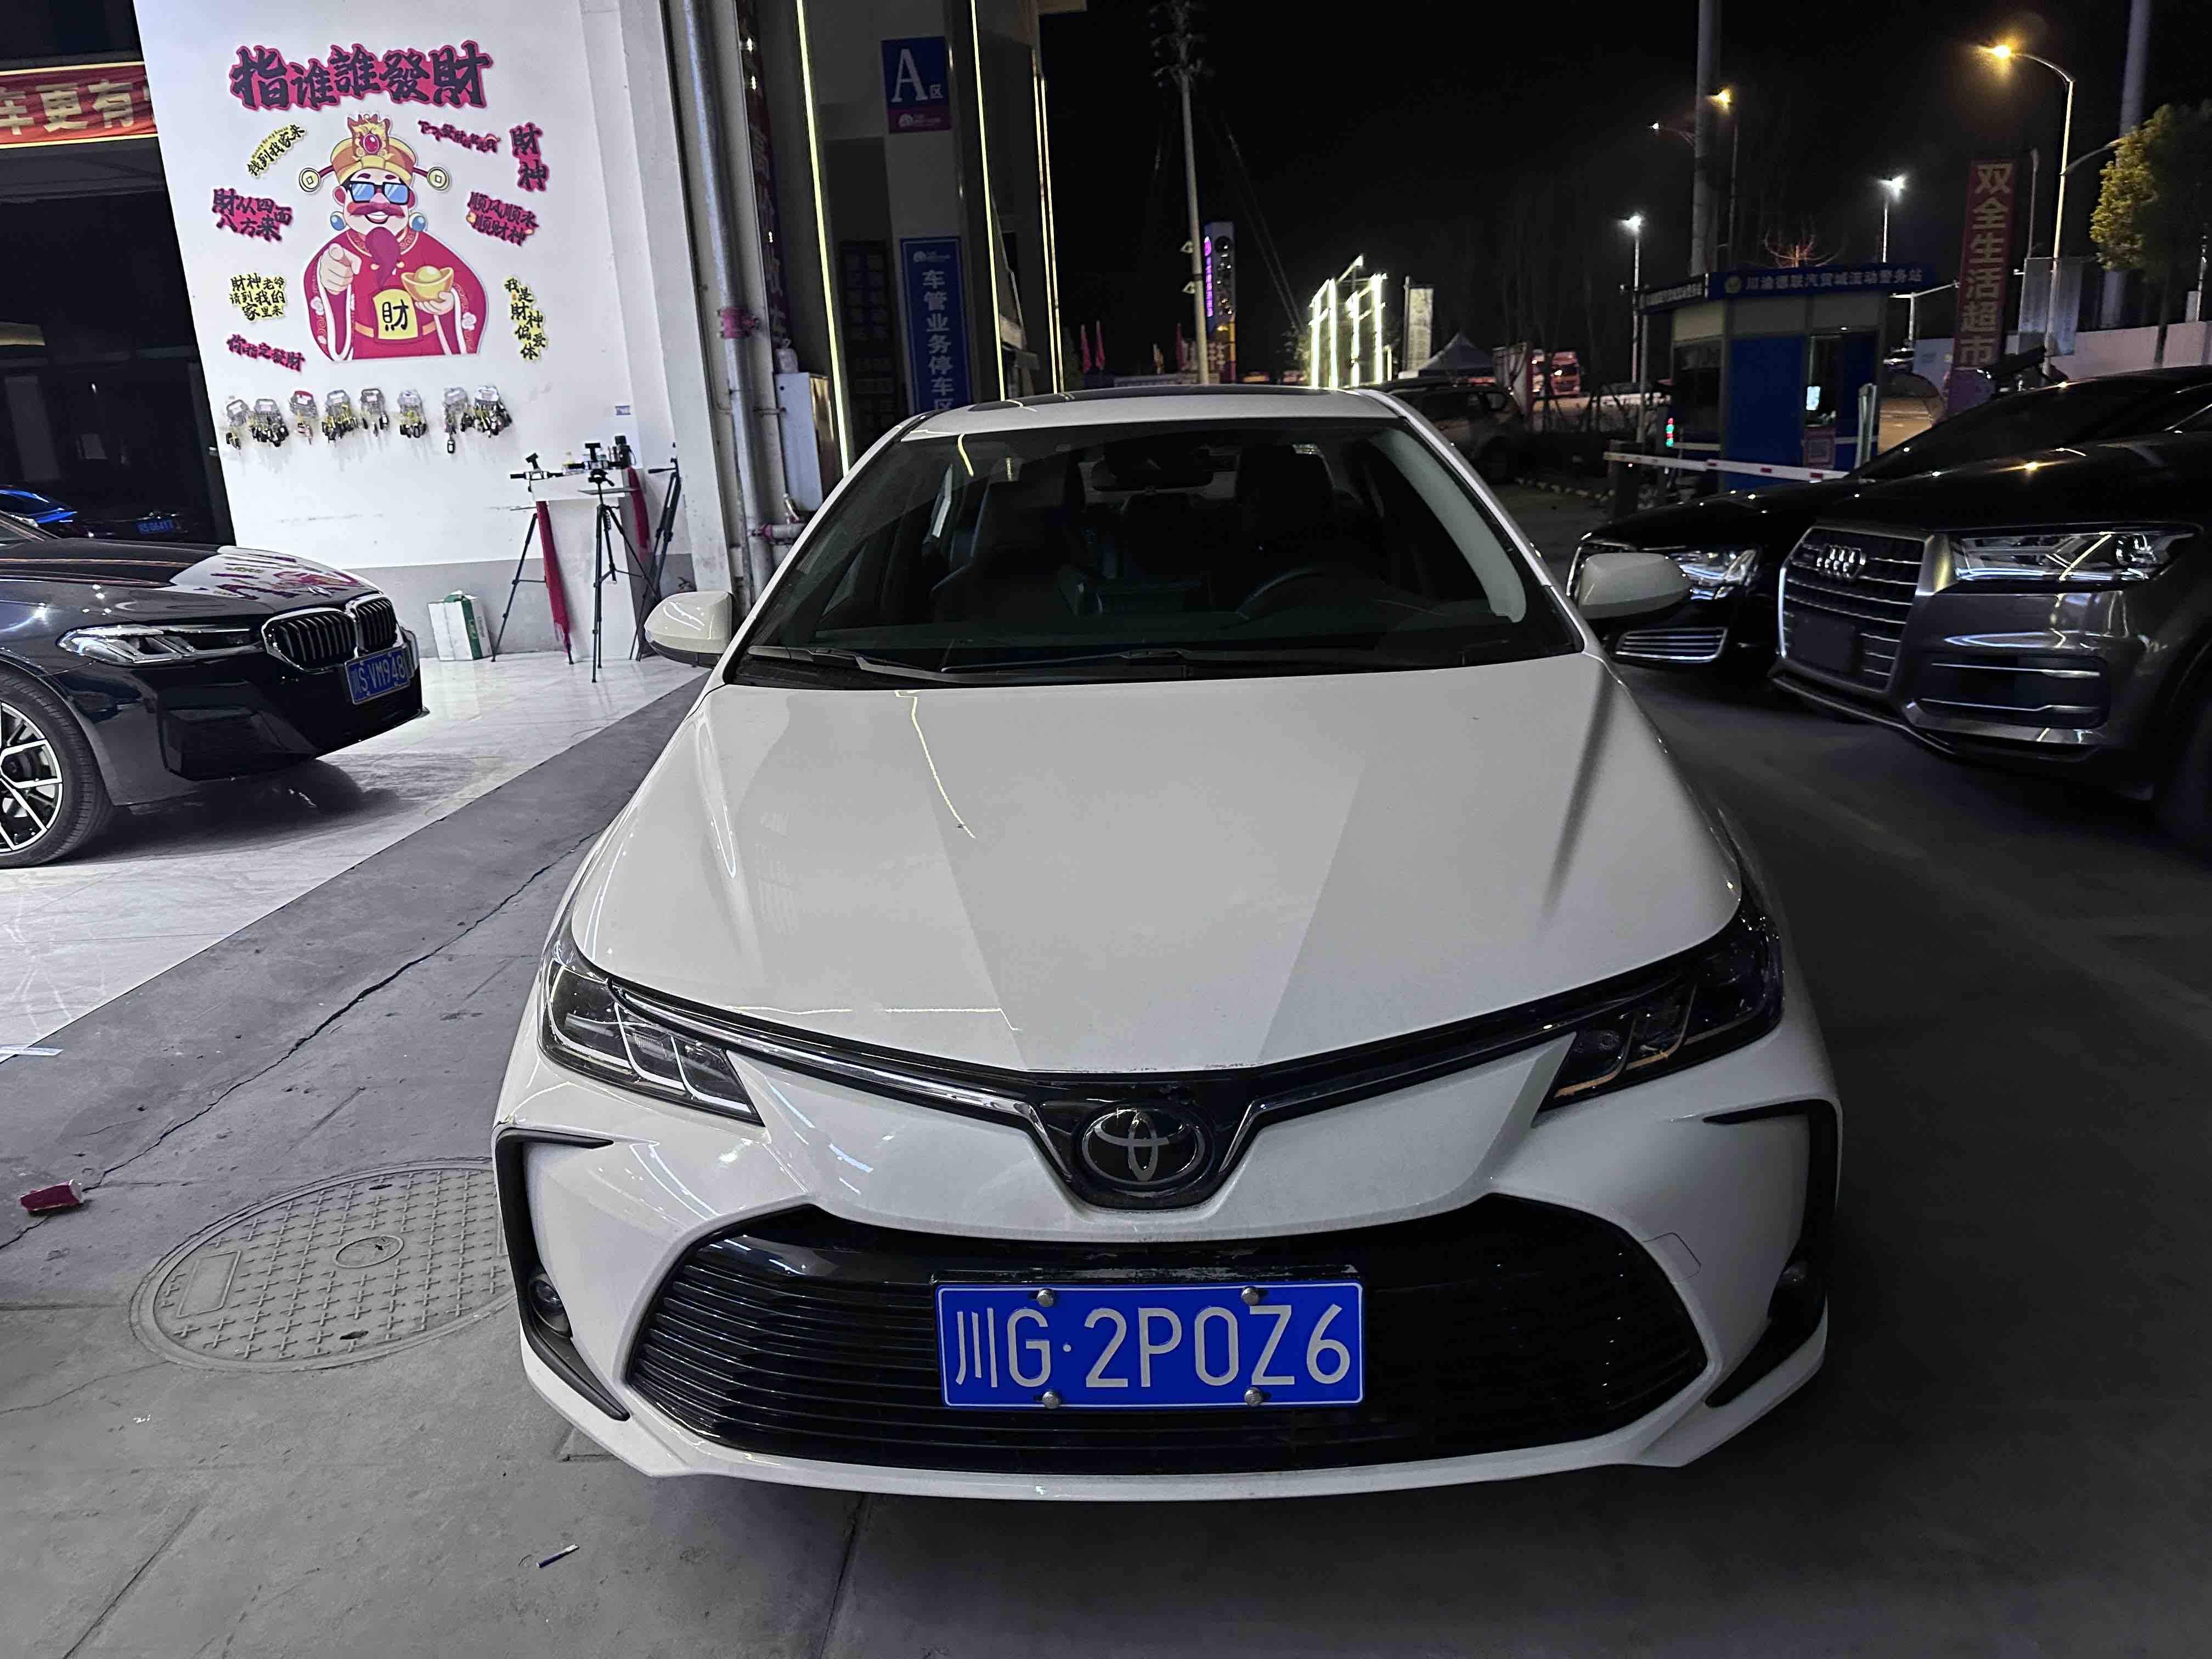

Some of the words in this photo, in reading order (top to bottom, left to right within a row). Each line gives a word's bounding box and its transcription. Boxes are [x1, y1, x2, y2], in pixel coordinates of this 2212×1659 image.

[0, 79, 155, 136] 车更有
[1960, 162, 2013, 366] 双全生活超市
[382, 299, 409, 331] 財
[922, 269, 955, 411] 车管业务停车区
[956, 1304, 1351, 1387] 川G·2P0Z6
